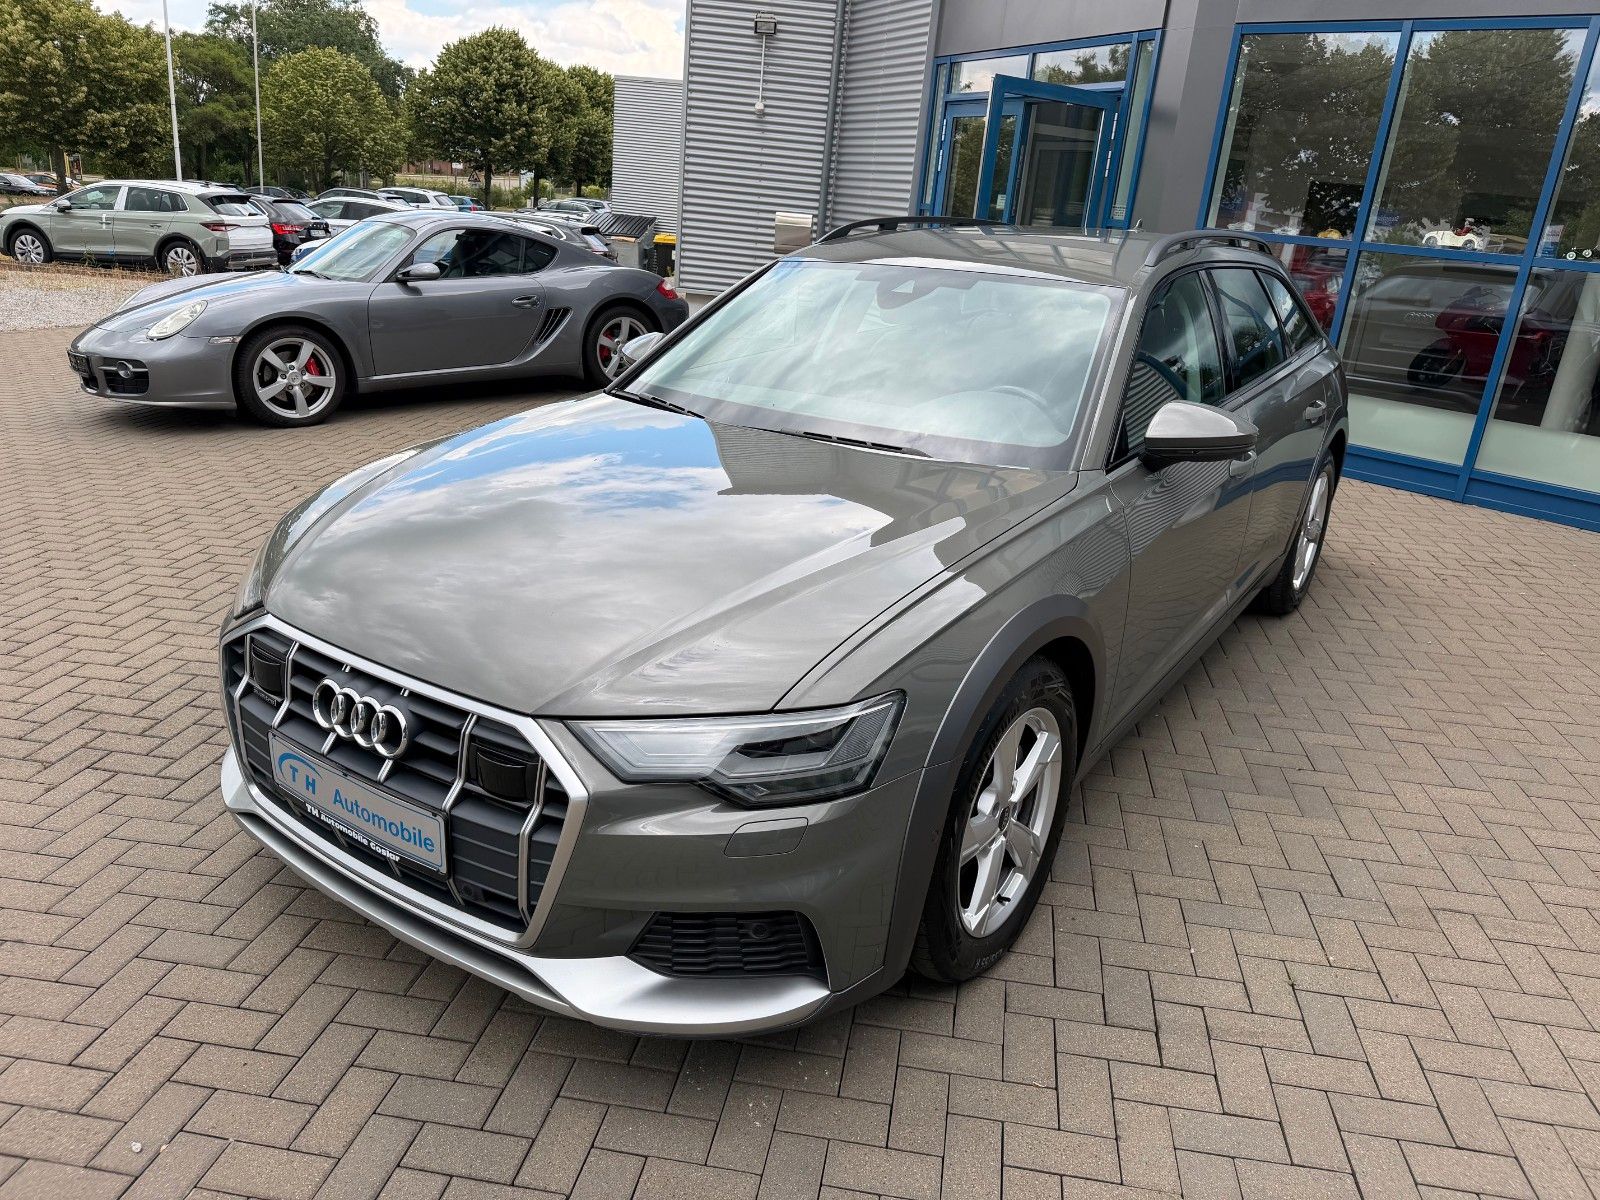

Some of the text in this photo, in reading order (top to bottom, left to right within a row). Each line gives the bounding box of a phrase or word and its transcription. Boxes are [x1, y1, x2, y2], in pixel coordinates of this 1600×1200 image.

[306, 803, 320, 818] TH
[320, 812, 369, 846] Automobile
[332, 788, 435, 853] Automobile
